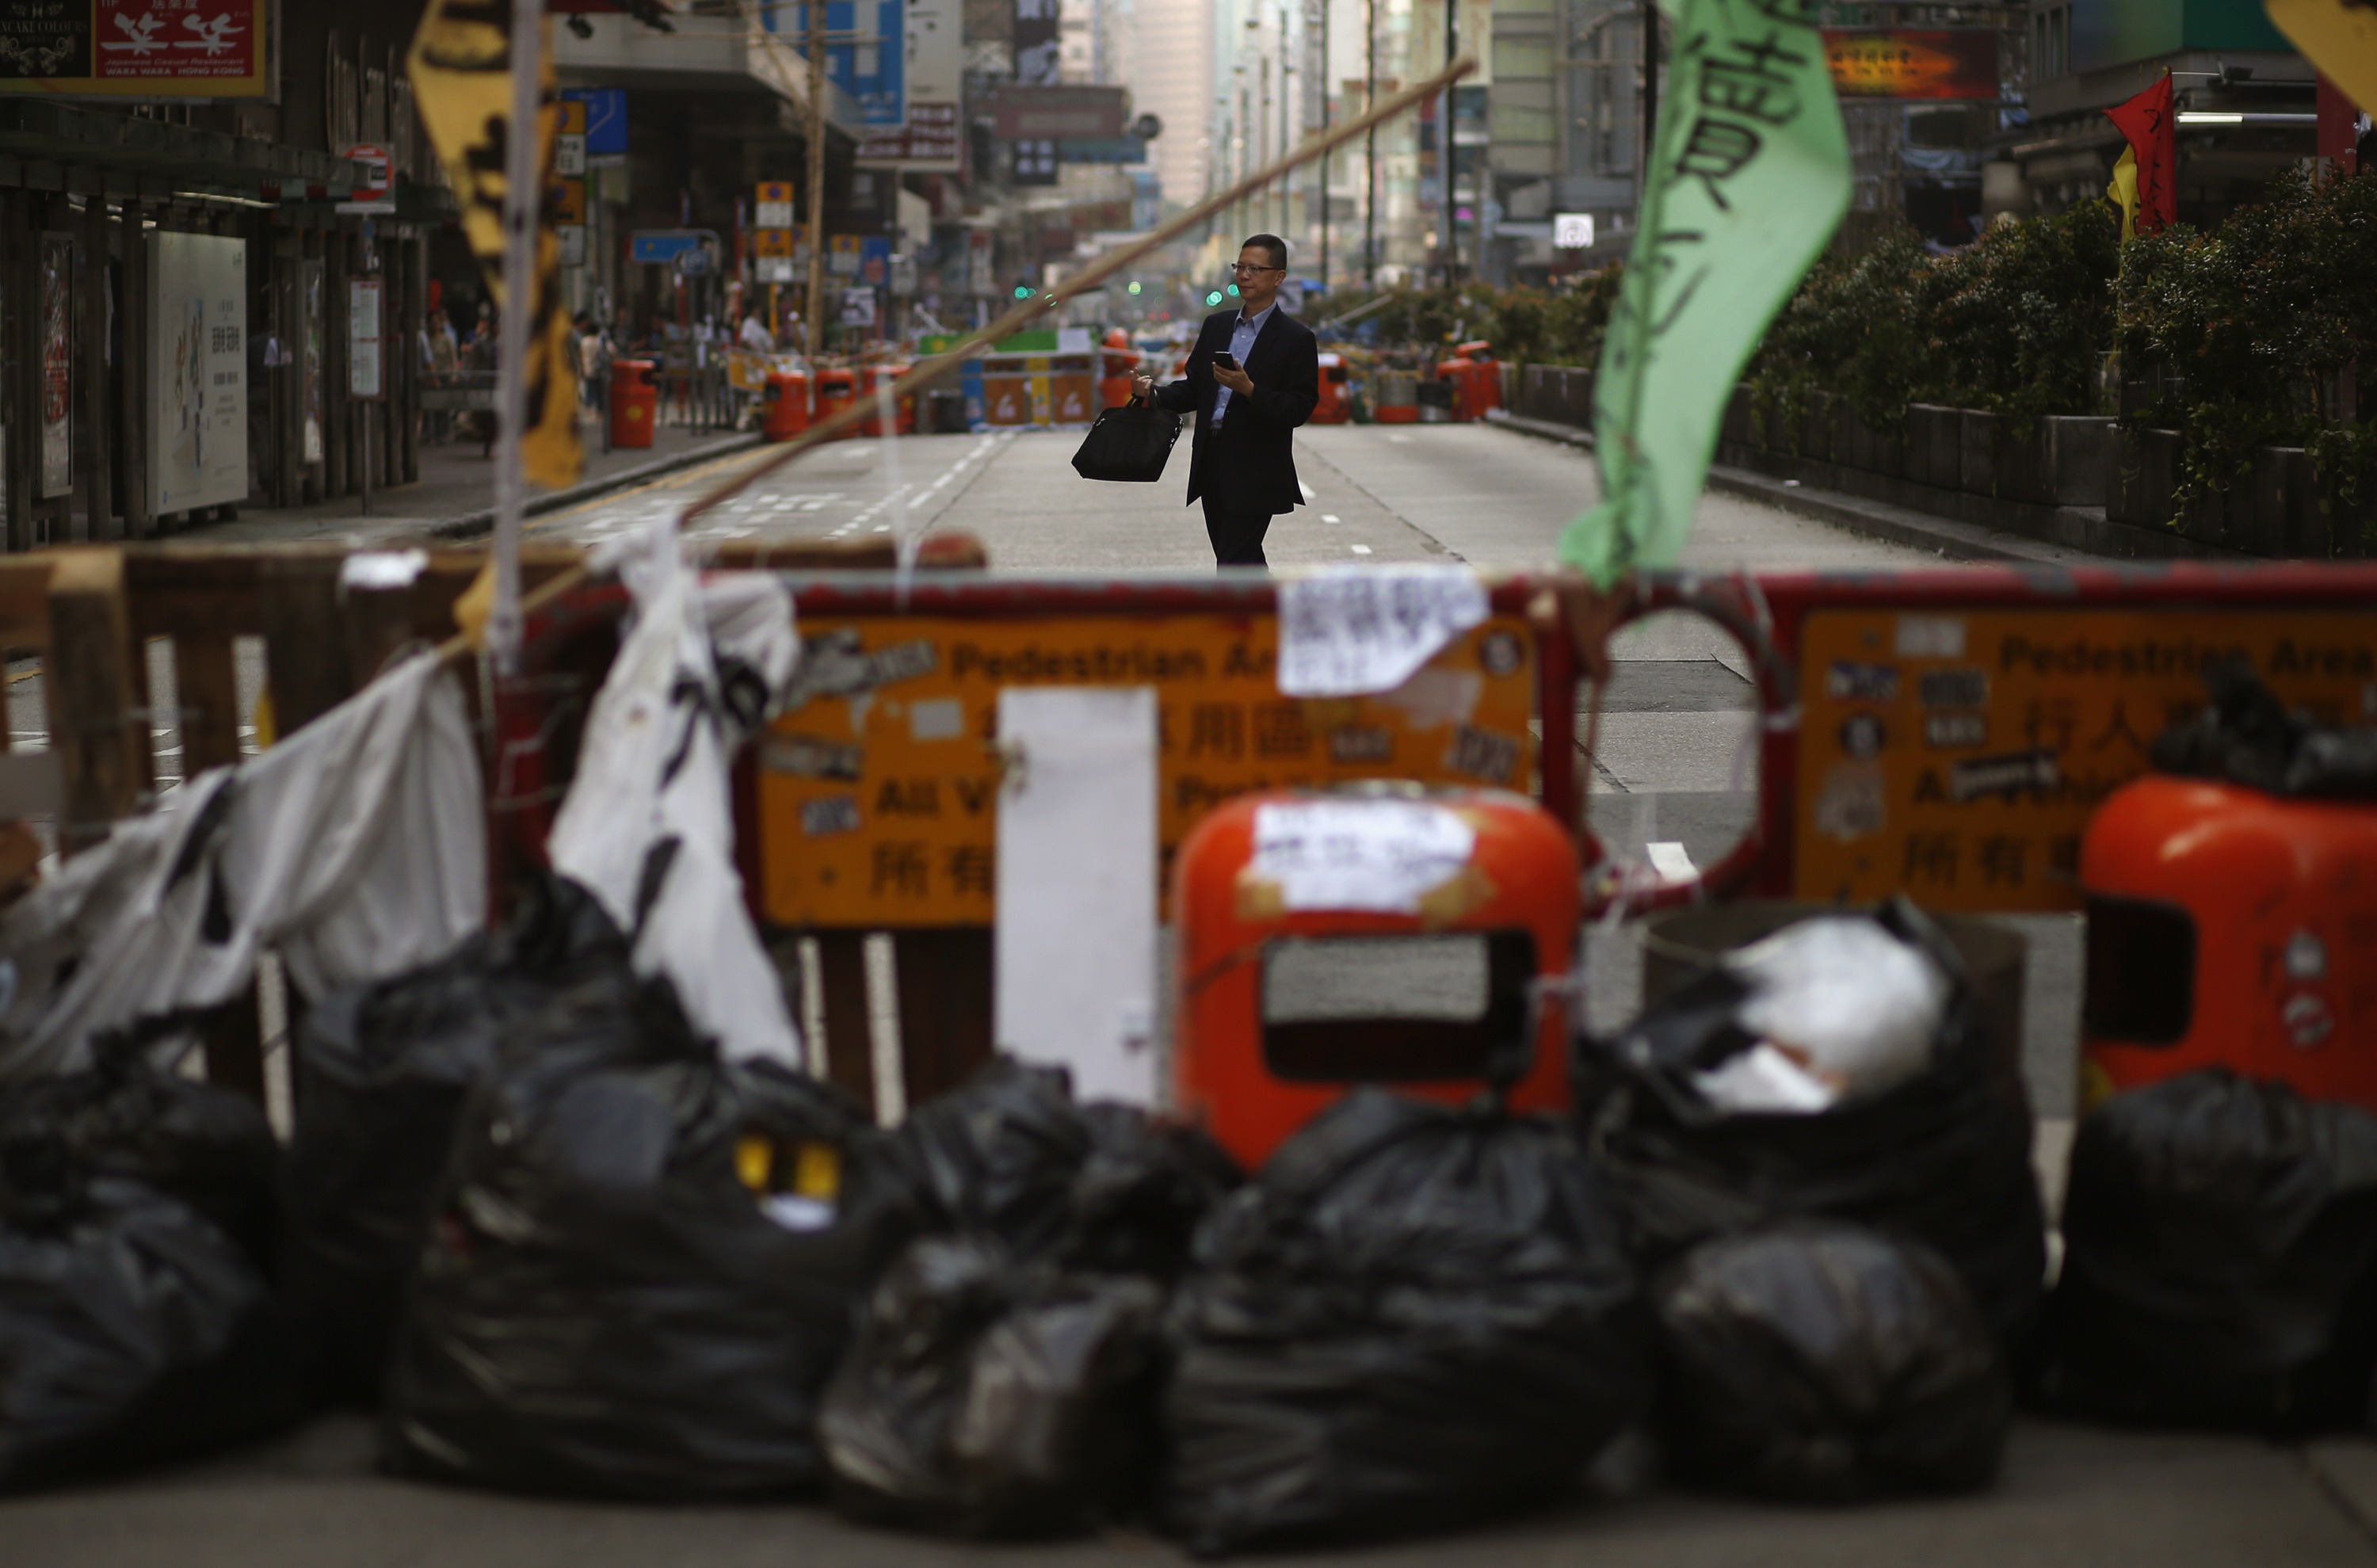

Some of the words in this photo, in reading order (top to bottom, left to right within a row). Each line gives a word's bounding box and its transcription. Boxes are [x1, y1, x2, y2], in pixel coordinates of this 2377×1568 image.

[37, 21, 88, 32] COLOURS
[178, 67, 209, 76] HONG
[213, 67, 246, 76] KONG
[950, 642, 1208, 681] Pedestrian
